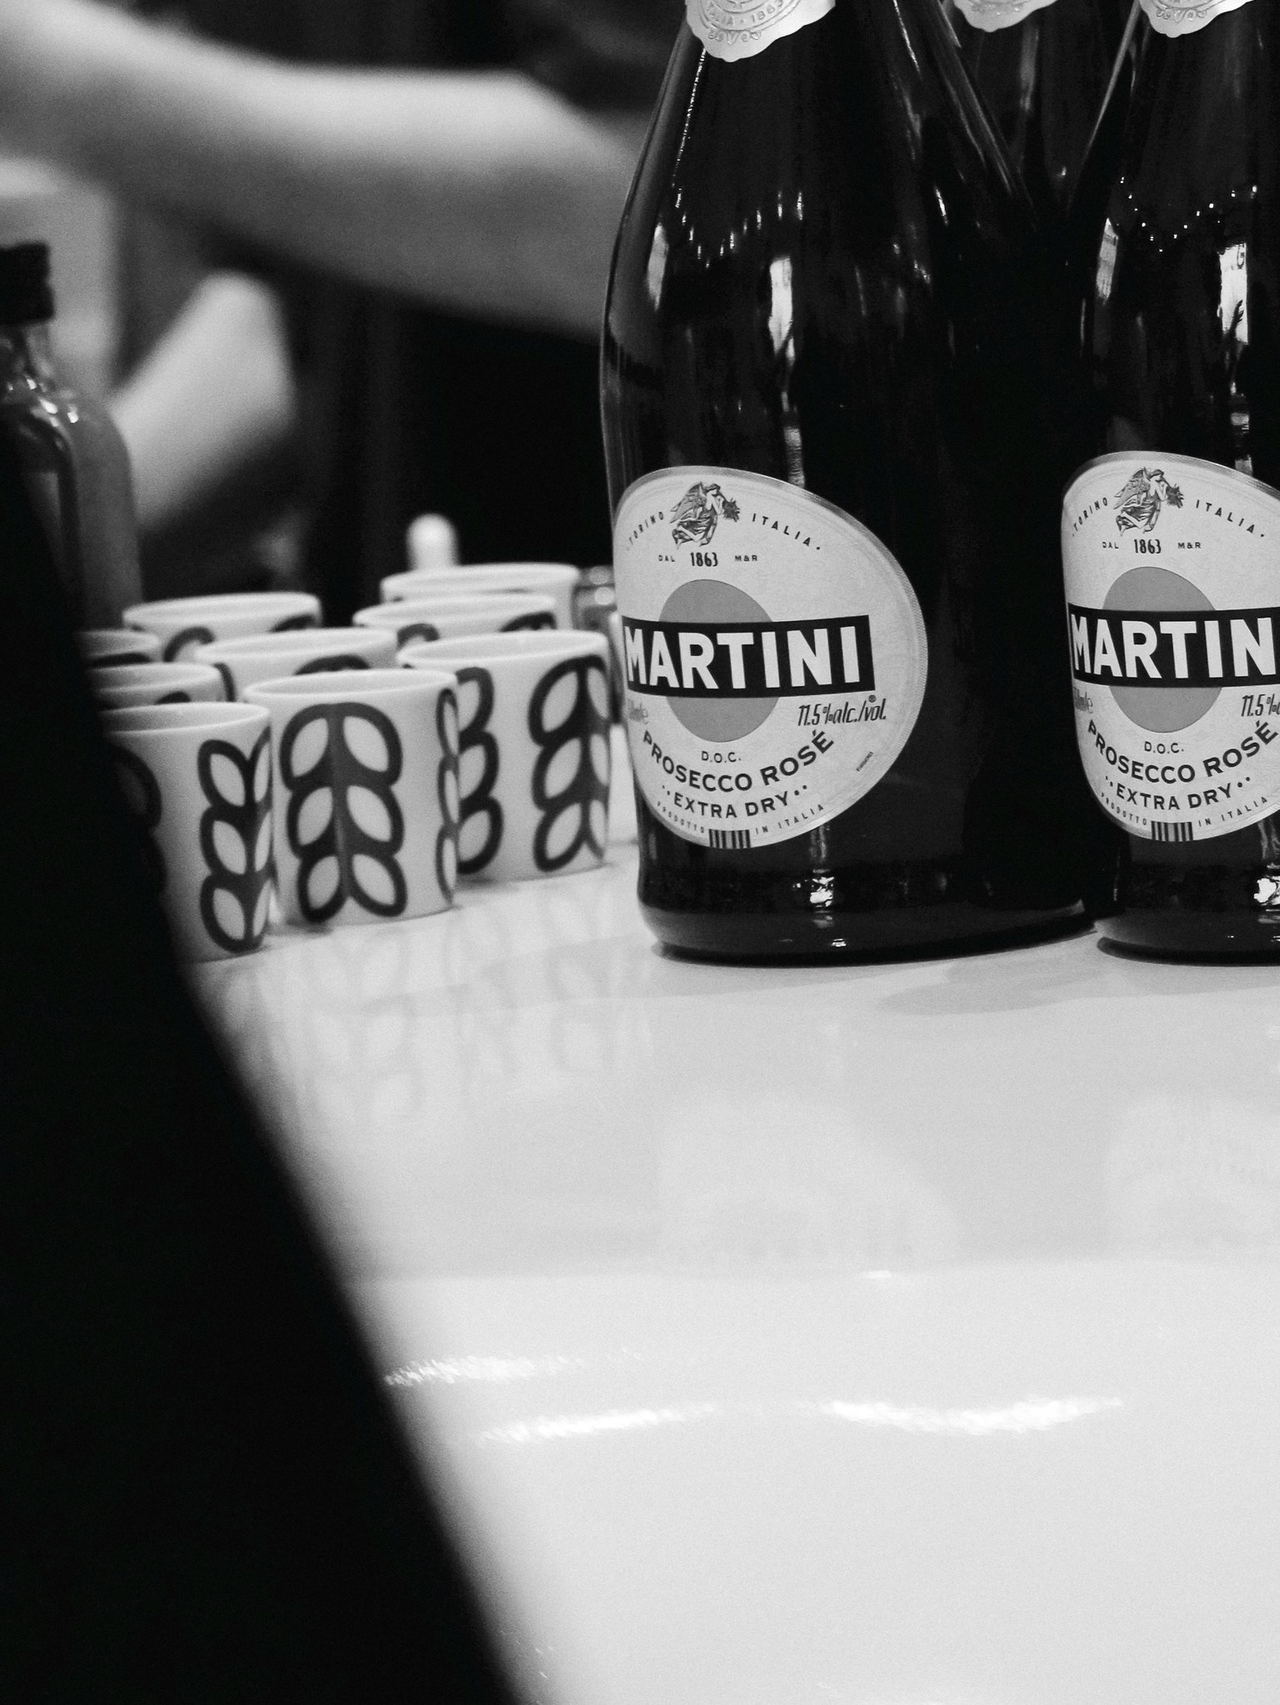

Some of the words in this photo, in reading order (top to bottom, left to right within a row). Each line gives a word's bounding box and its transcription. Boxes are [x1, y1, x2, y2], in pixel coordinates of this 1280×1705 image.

[628, 511, 665, 546] TORINO
[752, 512, 811, 546] ITALIA
[1073, 497, 1108, 532] TORINO
[1195, 499, 1256, 534] ITALIA
[690, 552, 719, 567] 1863
[734, 554, 758, 562] M&R
[1133, 539, 1162, 555] 1863
[1178, 541, 1202, 549] M&R
[624, 626, 860, 689] MARTINI
[643, 729, 751, 793] PROSECCO
[760, 729, 835, 786] ROSÉ
[701, 751, 741, 764] D.O.C.
[1088, 719, 1196, 784] PROSECCO
[1202, 719, 1279, 777] ROSÉ
[1144, 741, 1184, 755] D.O.C.
[674, 792, 738, 819] EXTRA
[745, 790, 788, 817] DRY
[1101, 792, 1147, 826] PRODOTTO
[1198, 818, 1212, 827] IN
[1221, 796, 1268, 822] ITALIA
[1116, 783, 1181, 811] EXTRA
[1187, 782, 1232, 809] DRY
[755, 826, 769, 835] IN
[778, 804, 824, 829] ITALIA
